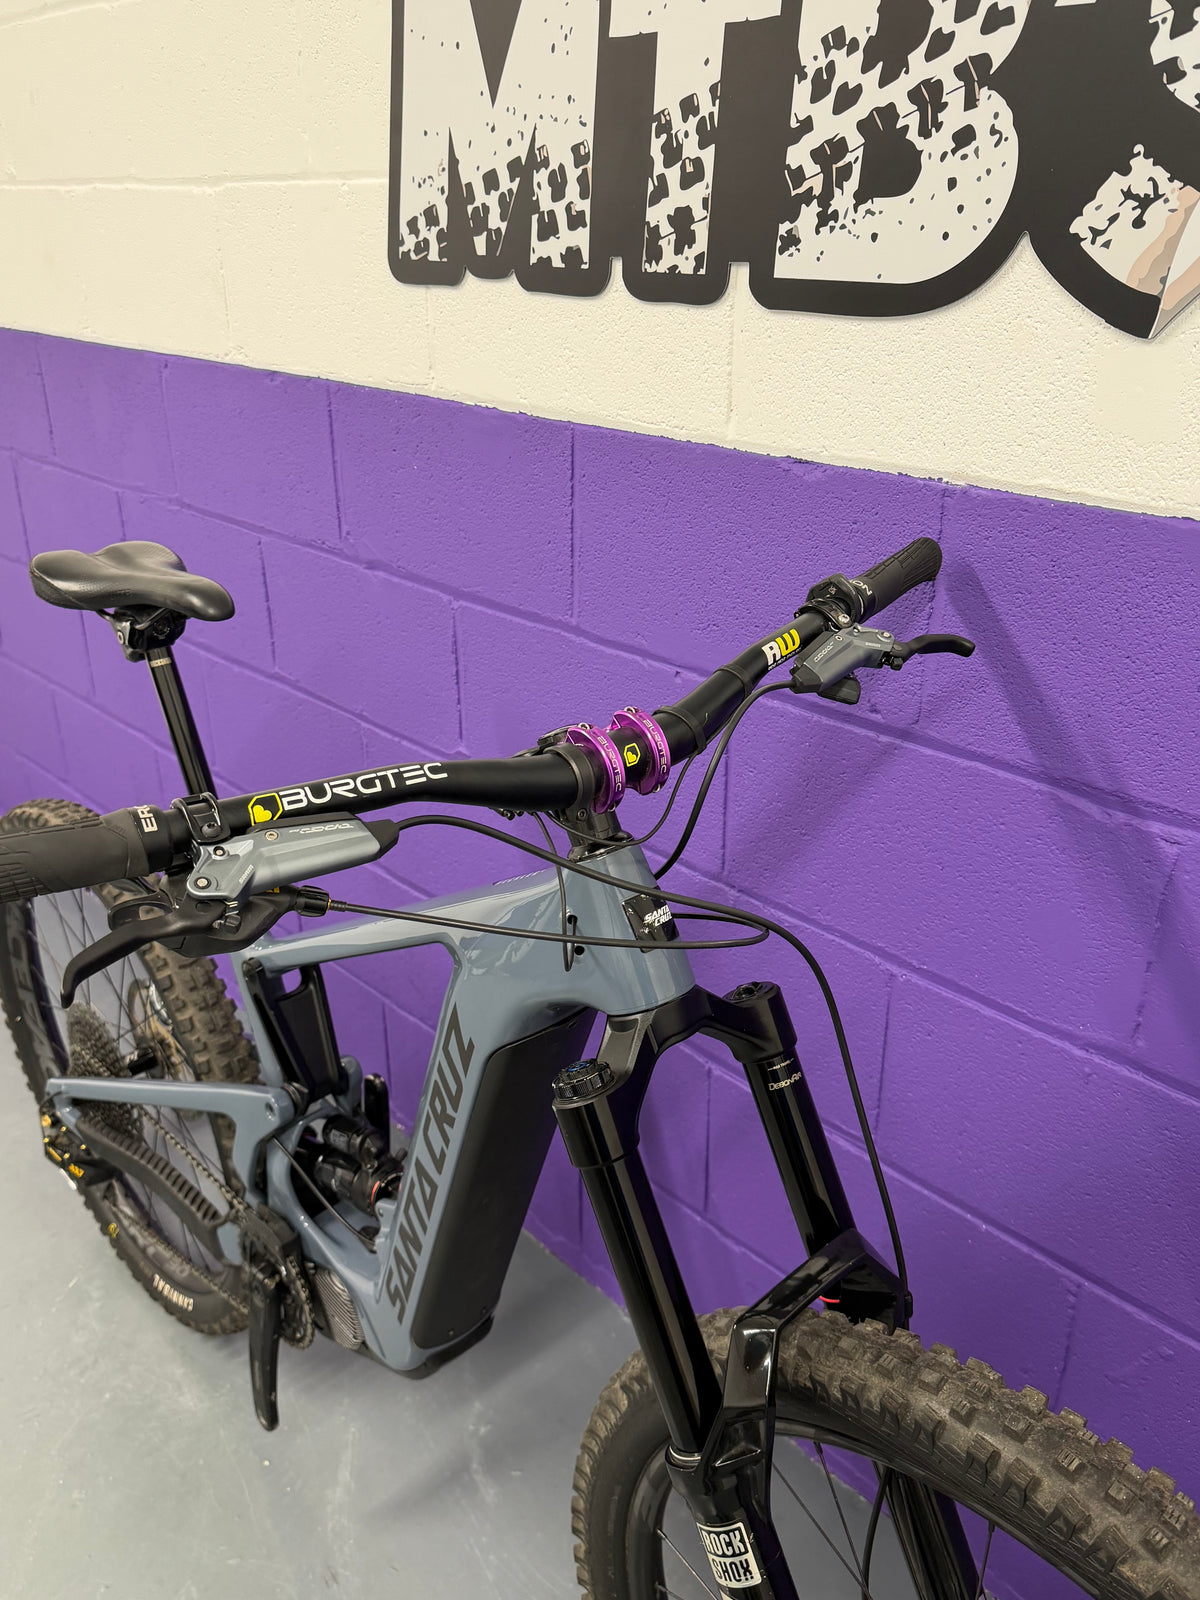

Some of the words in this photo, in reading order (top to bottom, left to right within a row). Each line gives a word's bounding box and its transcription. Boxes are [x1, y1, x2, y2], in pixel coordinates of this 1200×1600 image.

[597, 736, 622, 792] BURGTEC
[643, 719, 667, 774] BURGTEC
[279, 762, 448, 811] BURGTEC
[137, 804, 159, 833] ER
[386, 1155, 438, 1325] SANTA
[423, 1002, 475, 1175] CRUZ
[702, 1530, 746, 1556] ROCK
[711, 1558, 754, 1582] SHOX
